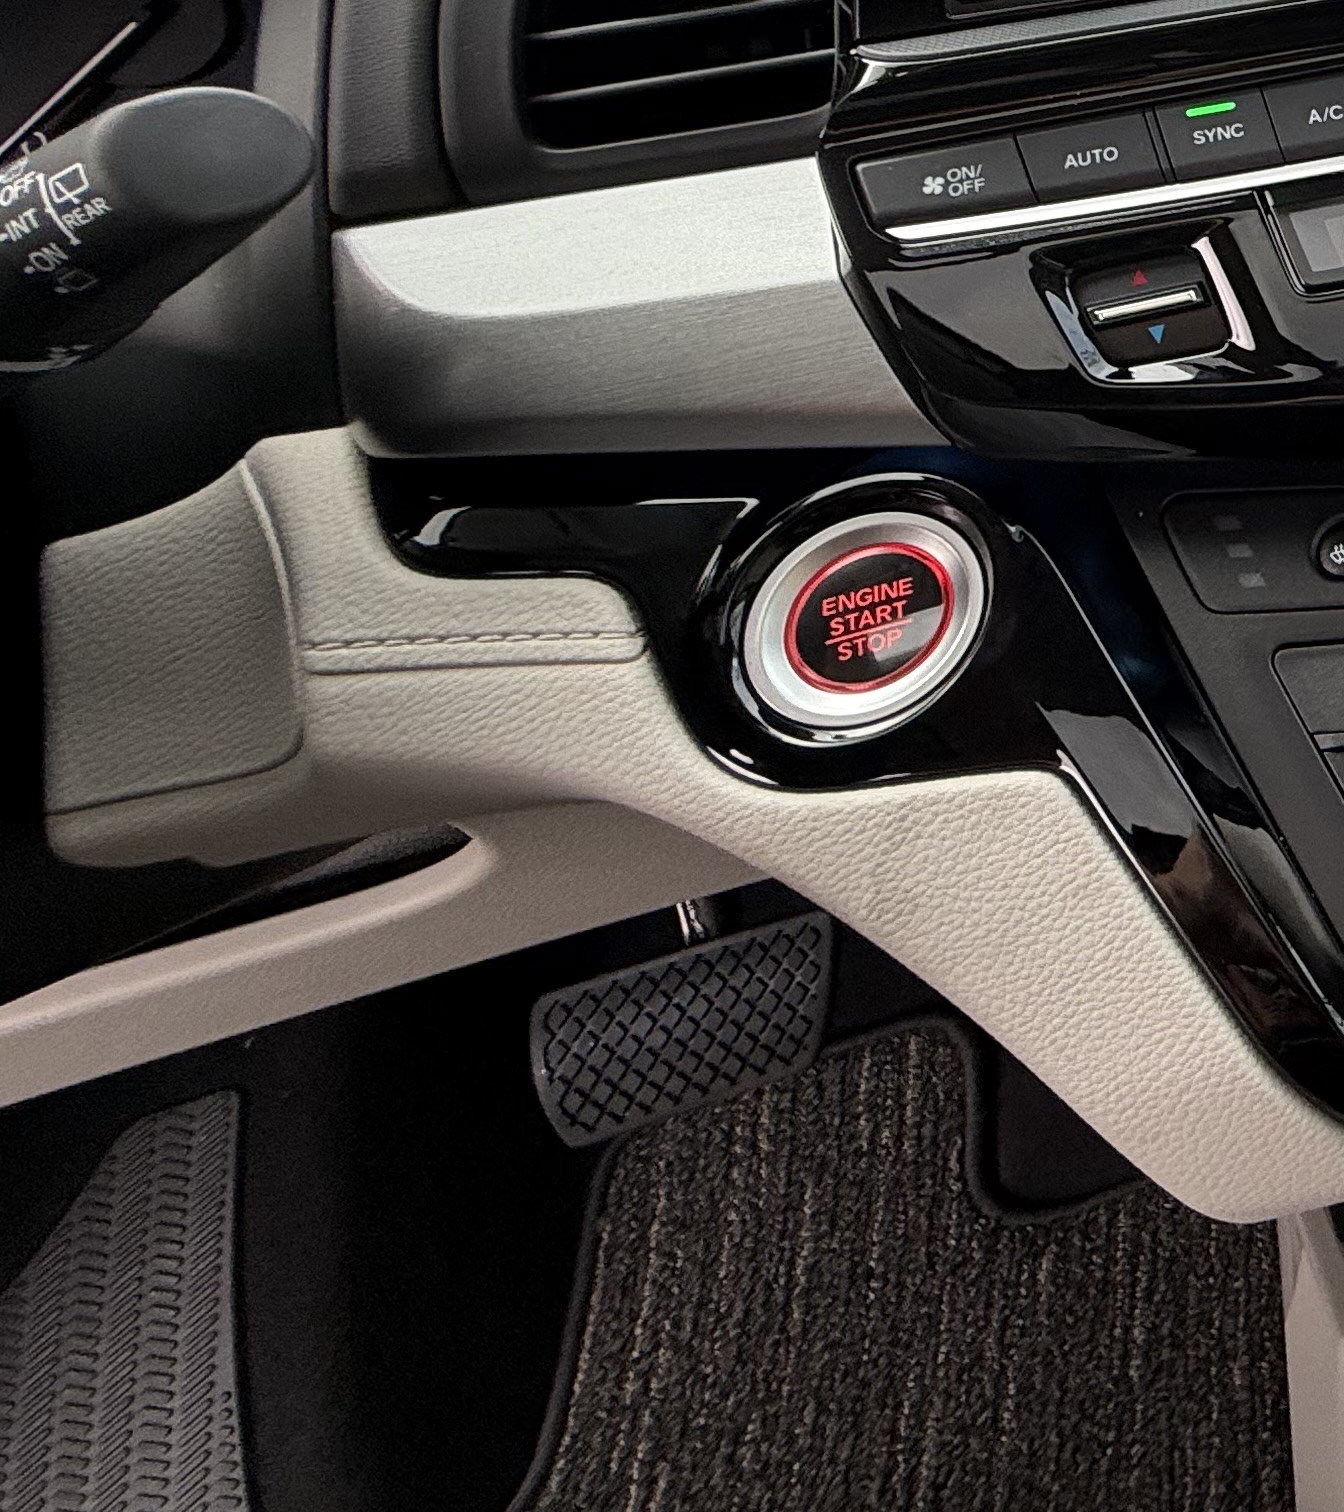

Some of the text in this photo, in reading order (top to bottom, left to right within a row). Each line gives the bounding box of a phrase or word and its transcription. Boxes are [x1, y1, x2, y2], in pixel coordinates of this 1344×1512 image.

[1307, 104, 1344, 125] A/C
[1192, 123, 1245, 145] SYNC
[946, 164, 983, 182] ON/
[1063, 146, 1119, 169] AUTO
[0, 170, 36, 207] OFF
[948, 177, 985, 198] OFF
[4, 208, 40, 242] INT
[61, 197, 113, 230] REAR
[28, 242, 69, 272] ON
[821, 577, 913, 617] ENGINE
[828, 601, 908, 638] START
[836, 628, 903, 662] STOP
